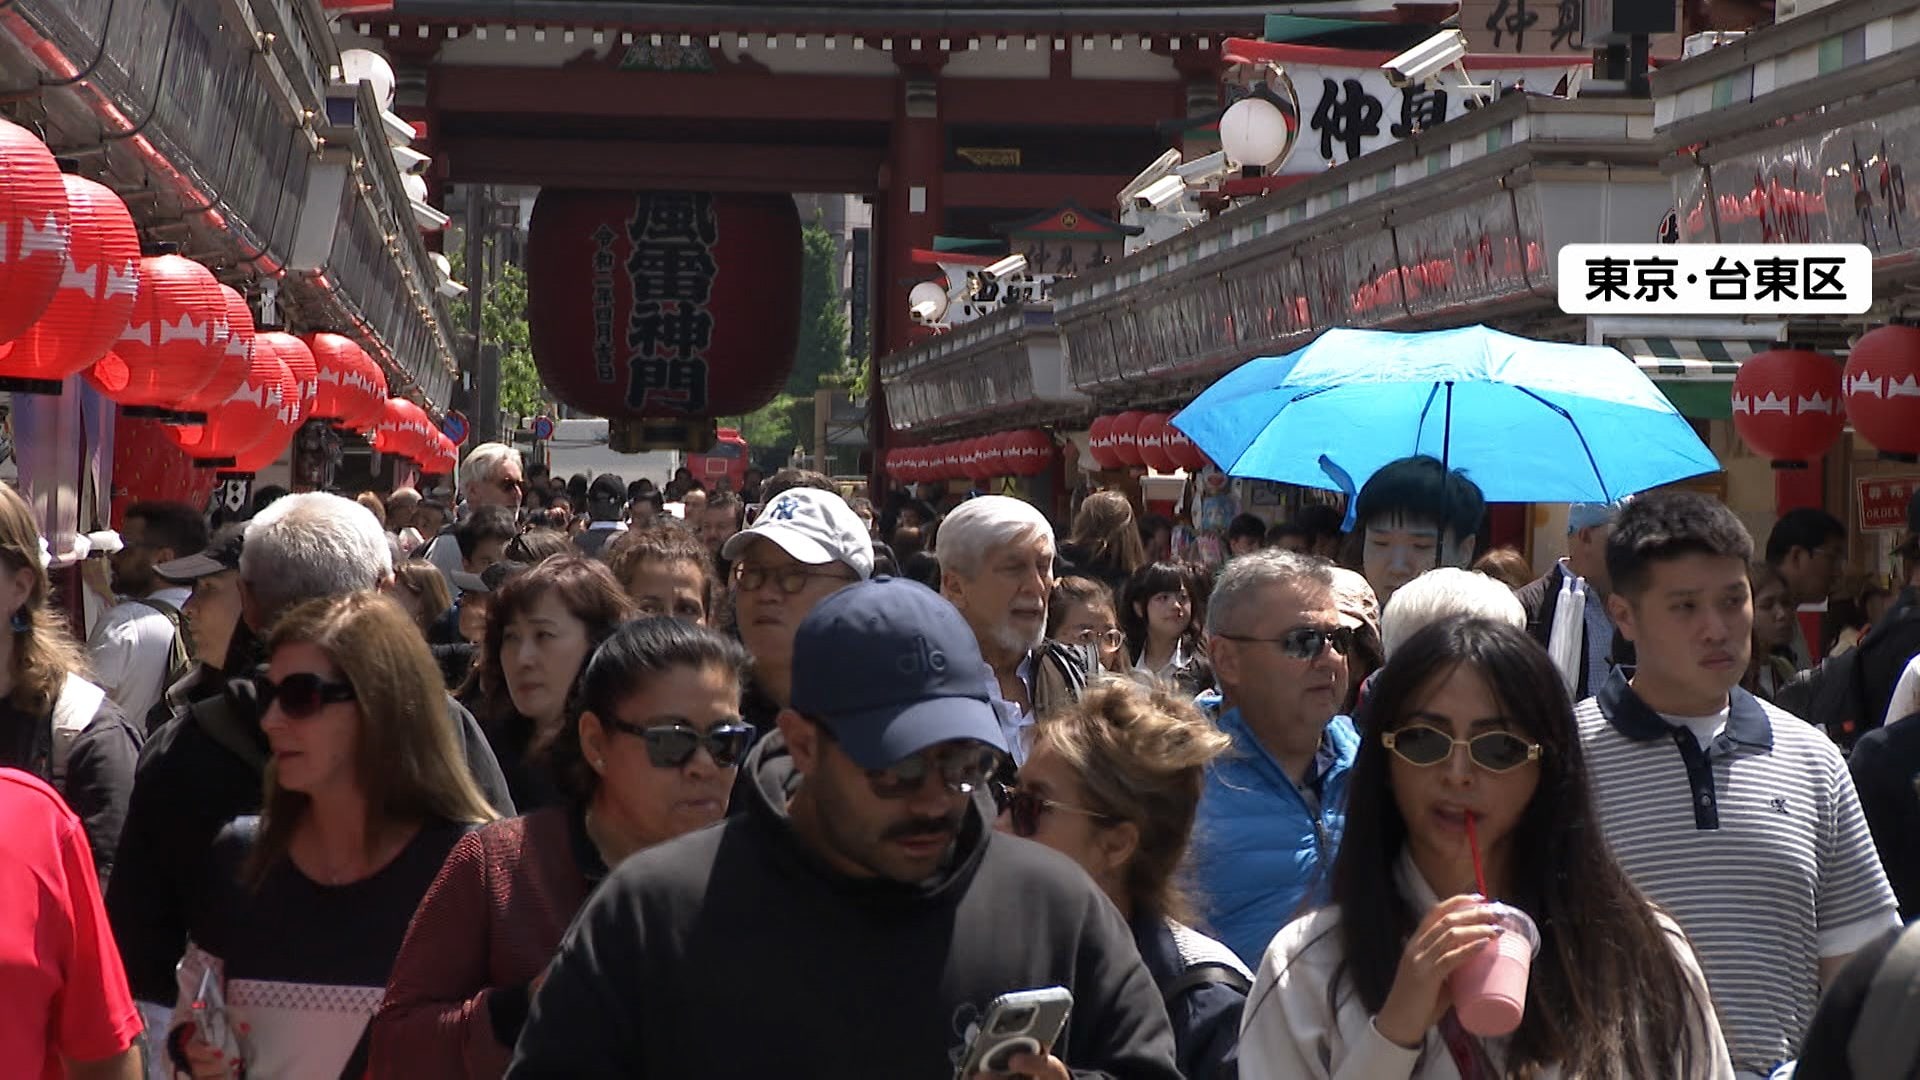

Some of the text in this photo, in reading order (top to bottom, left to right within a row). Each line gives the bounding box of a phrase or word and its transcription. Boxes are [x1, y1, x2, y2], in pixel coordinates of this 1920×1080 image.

[624, 191, 720, 411] 風雷神門
[1865, 505, 1900, 520] ORDER
